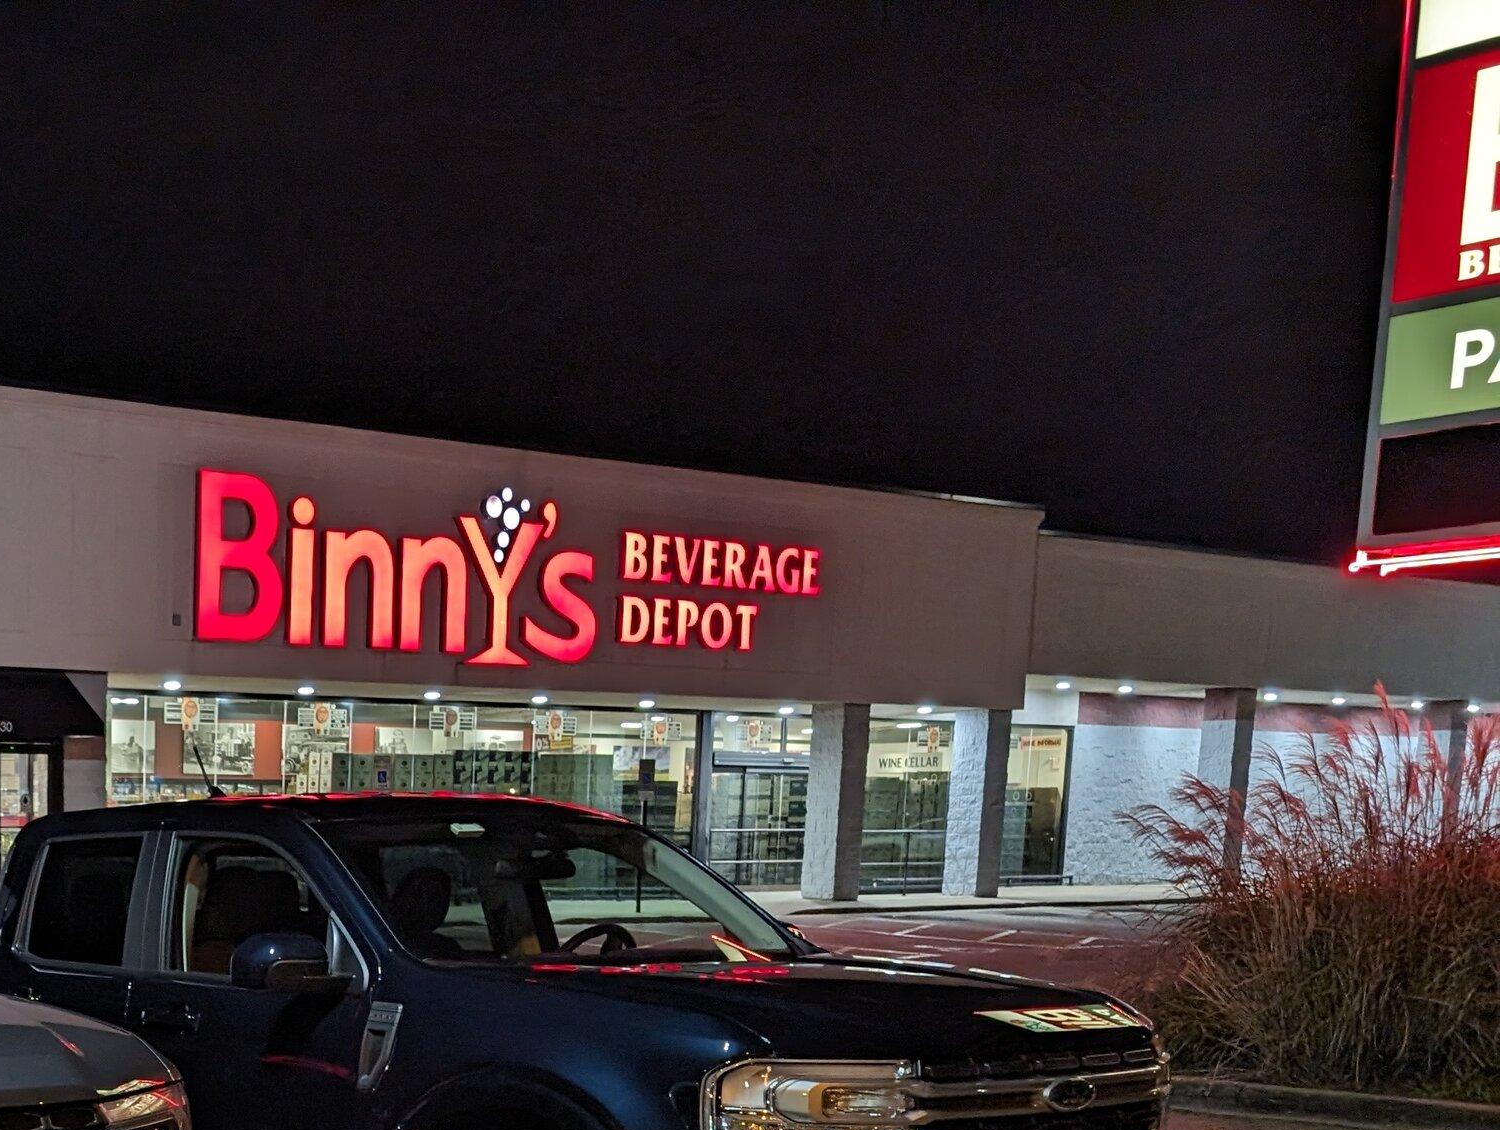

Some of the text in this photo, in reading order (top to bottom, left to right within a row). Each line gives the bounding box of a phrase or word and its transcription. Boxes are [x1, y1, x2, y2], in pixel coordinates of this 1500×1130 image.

[622, 530, 821, 596] BEVERAGE
[619, 595, 759, 651] DEPOT
[879, 756, 939, 768] WINE CELLAR
